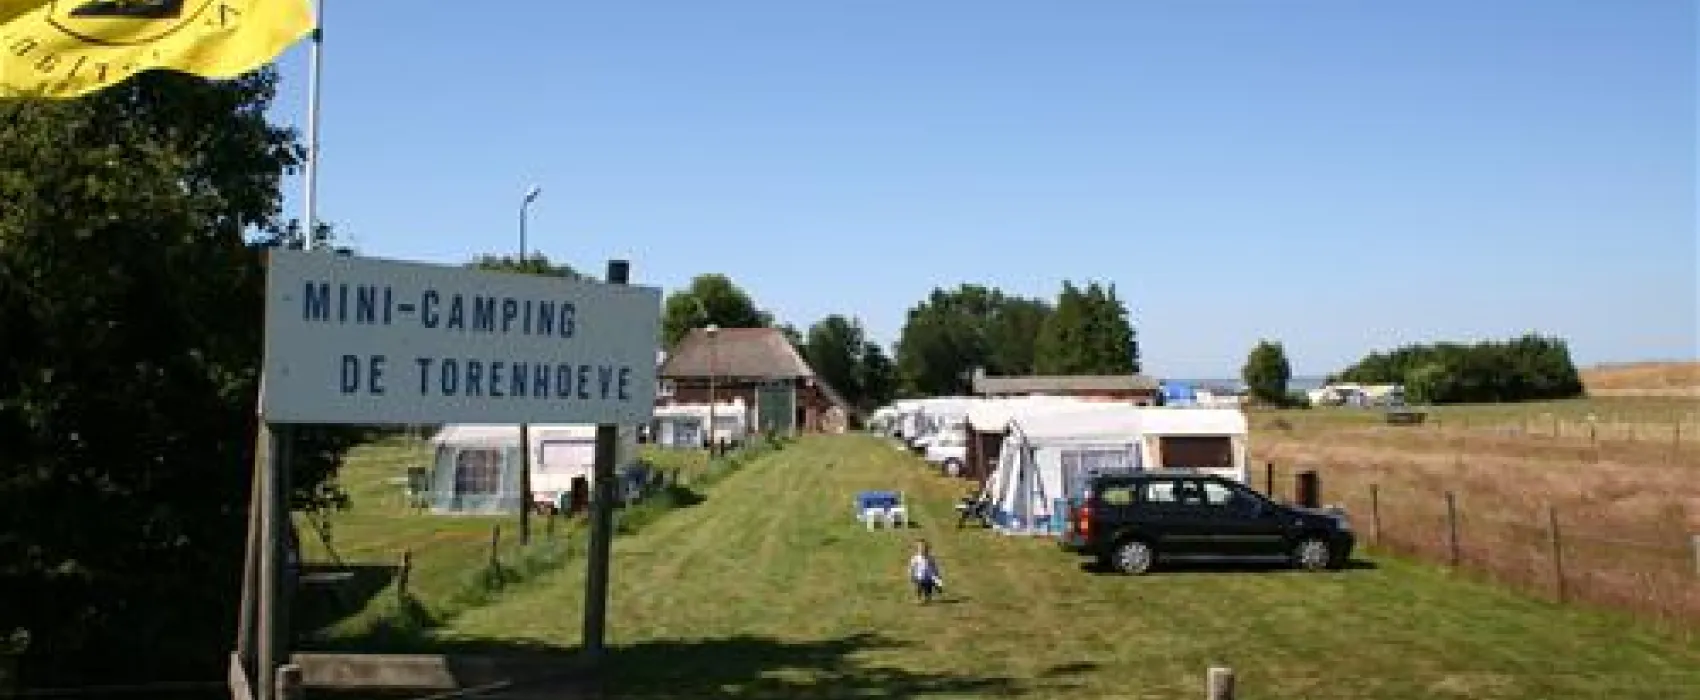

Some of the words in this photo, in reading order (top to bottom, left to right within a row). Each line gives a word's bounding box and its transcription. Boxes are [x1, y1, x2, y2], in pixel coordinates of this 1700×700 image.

[303, 280, 577, 338] MINI-CAMPING
[340, 354, 387, 396] DE
[415, 357, 632, 401] TORENHOEVE
